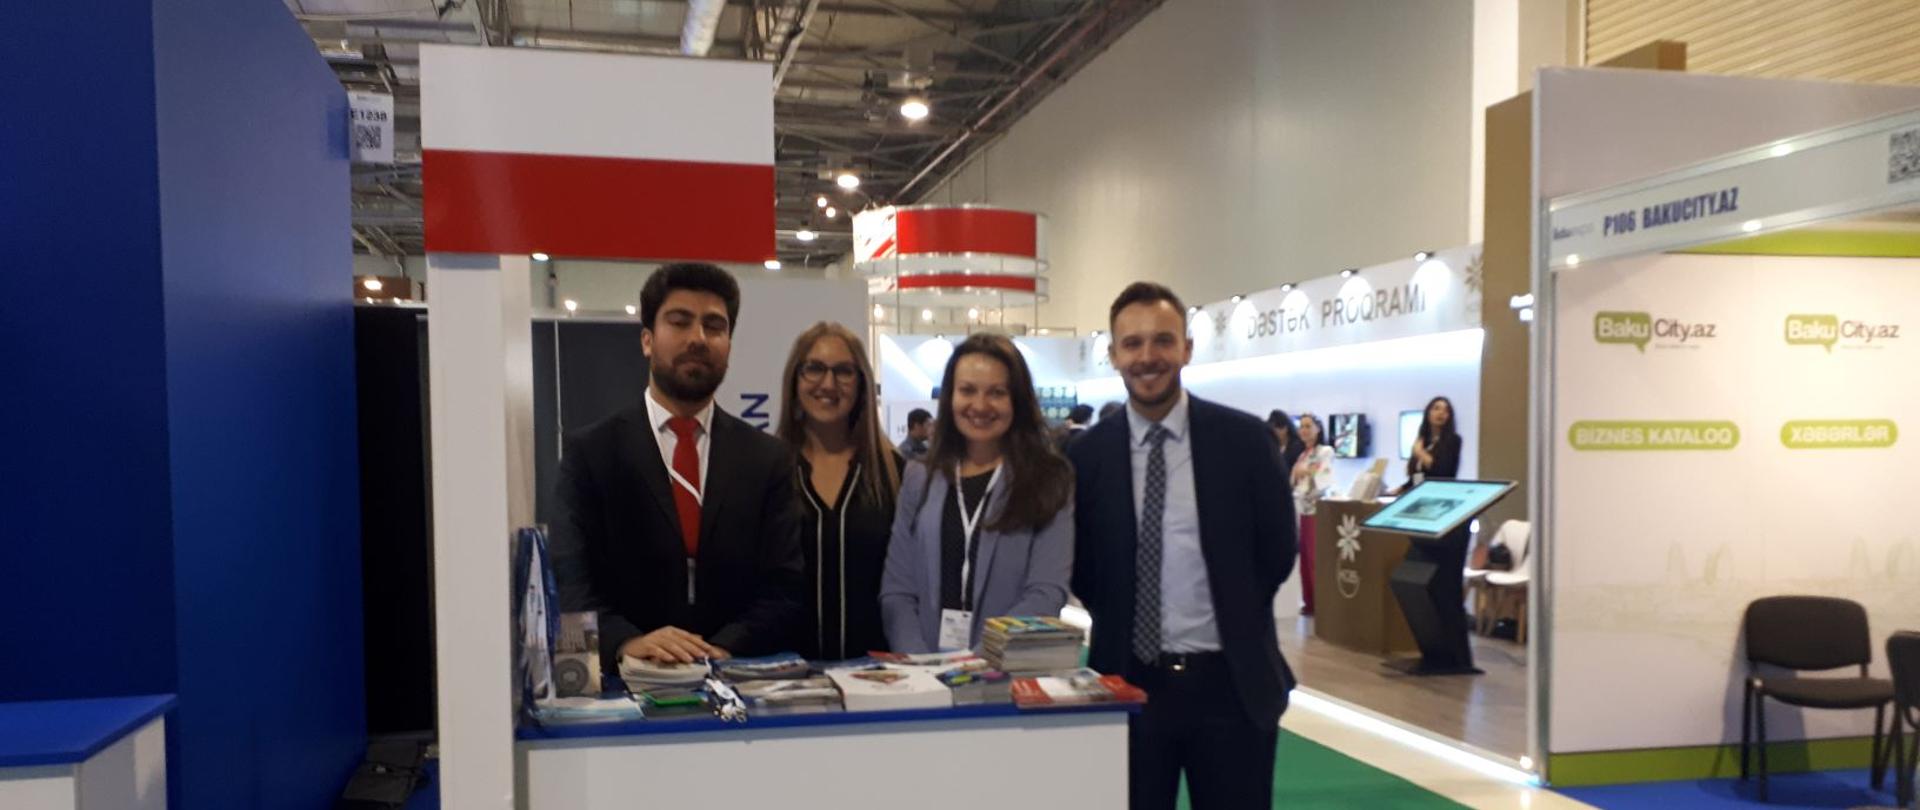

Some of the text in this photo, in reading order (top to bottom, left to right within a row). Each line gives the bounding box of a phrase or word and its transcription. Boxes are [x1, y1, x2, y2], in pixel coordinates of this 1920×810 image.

[1603, 210, 1637, 237] P106
[1642, 187, 1739, 230] BAKUCITY.AZ
[1599, 317, 1717, 343] Baku City.az
[1788, 319, 1900, 343] Baku City.az
[740, 393, 769, 430] N
